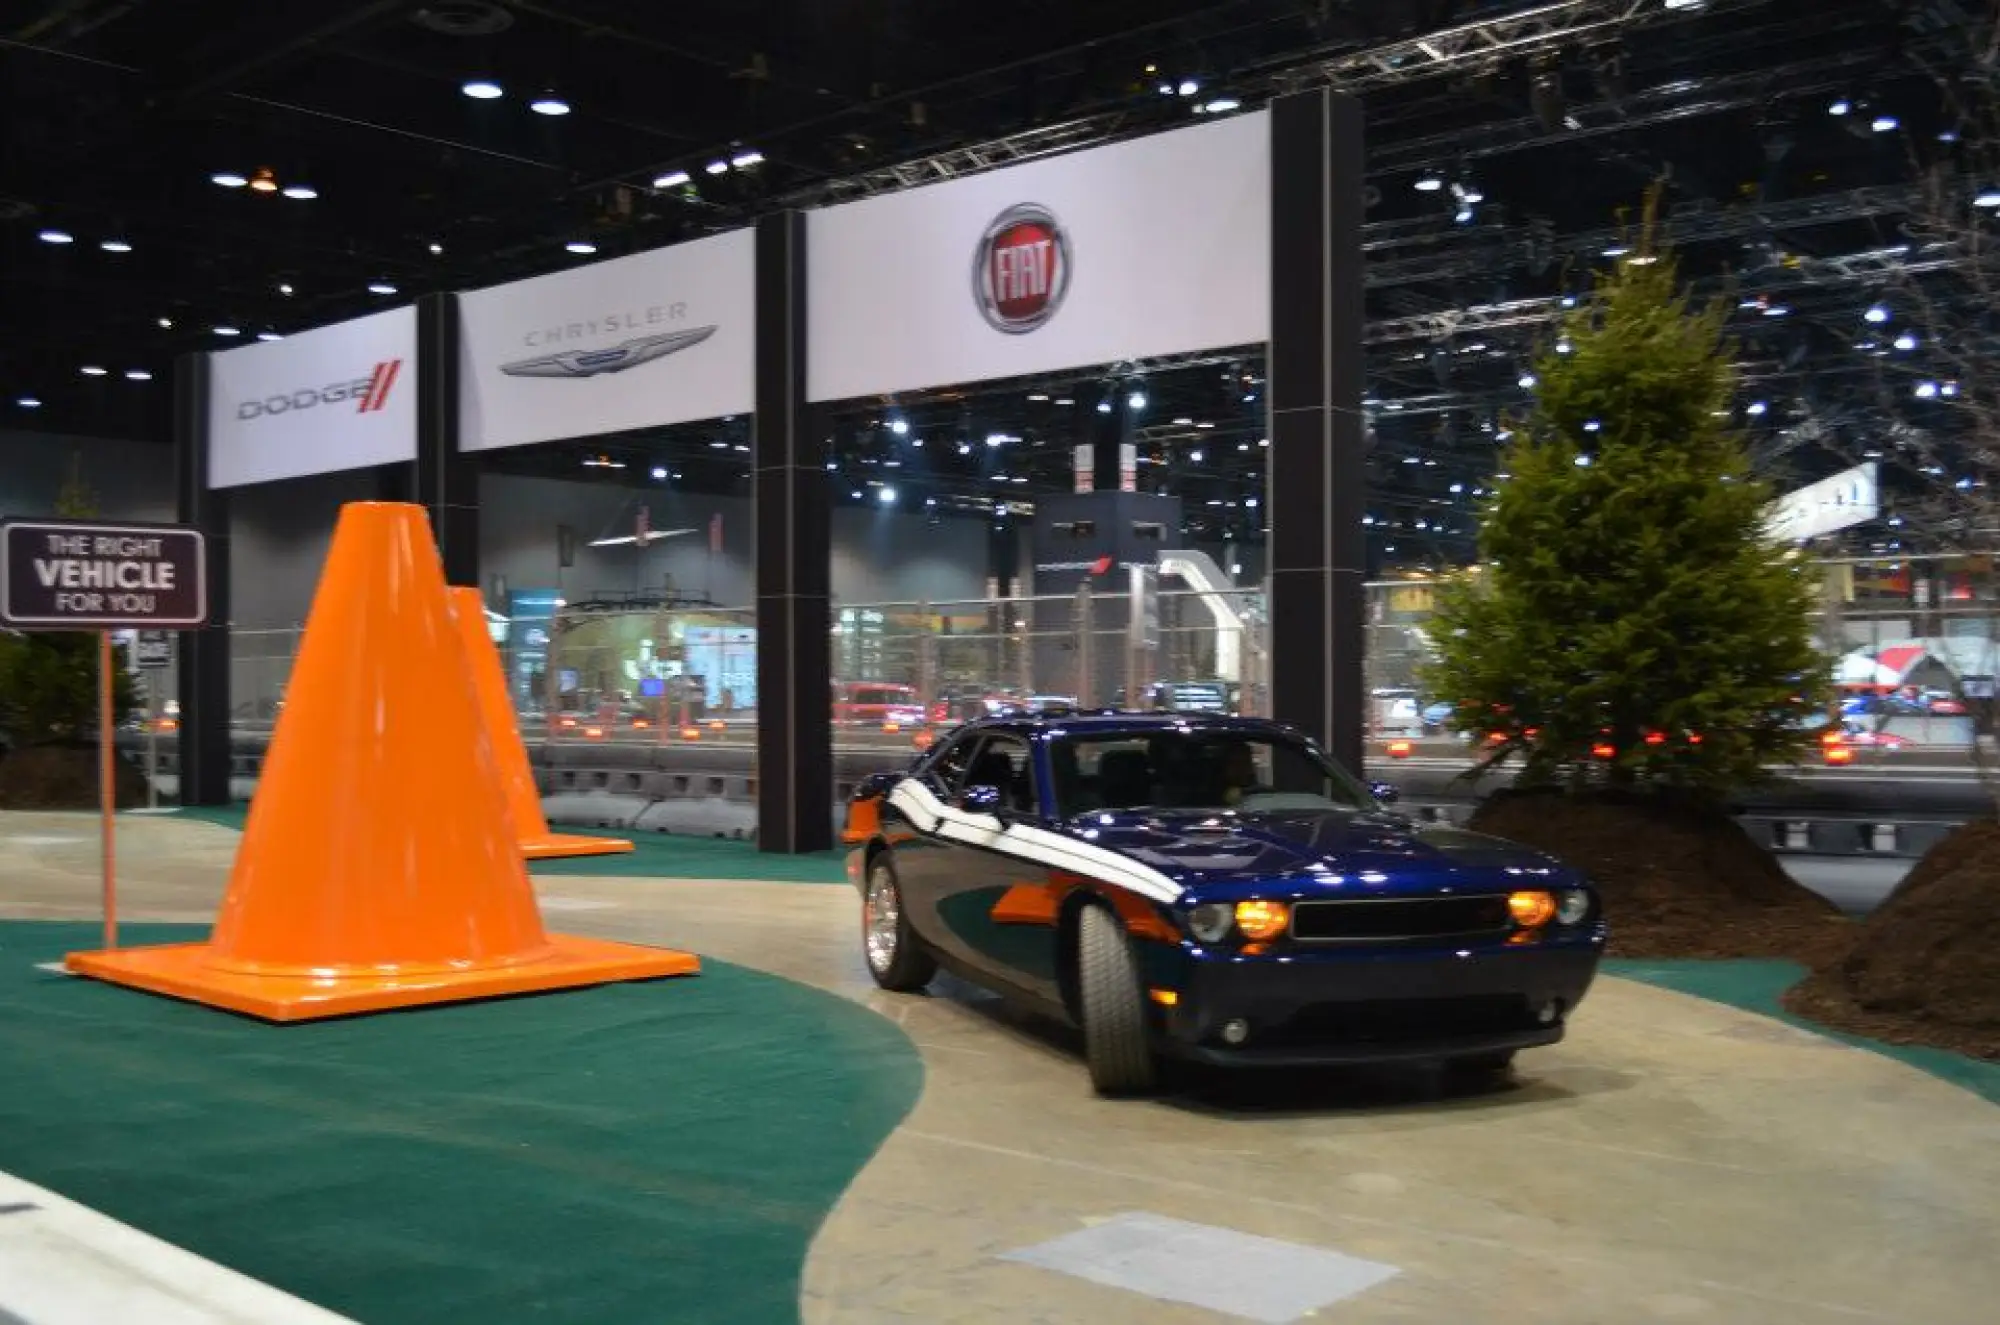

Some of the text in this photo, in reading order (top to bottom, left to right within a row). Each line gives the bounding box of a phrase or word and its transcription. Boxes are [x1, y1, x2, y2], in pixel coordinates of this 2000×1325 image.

[996, 240, 1051, 301] FIAT
[525, 302, 688, 347] CHRYSLER
[237, 379, 375, 420] DODGE
[48, 535, 162, 557] THE RIGHT
[34, 559, 174, 589] VEHICLE
[56, 593, 155, 612] FOR YOU
